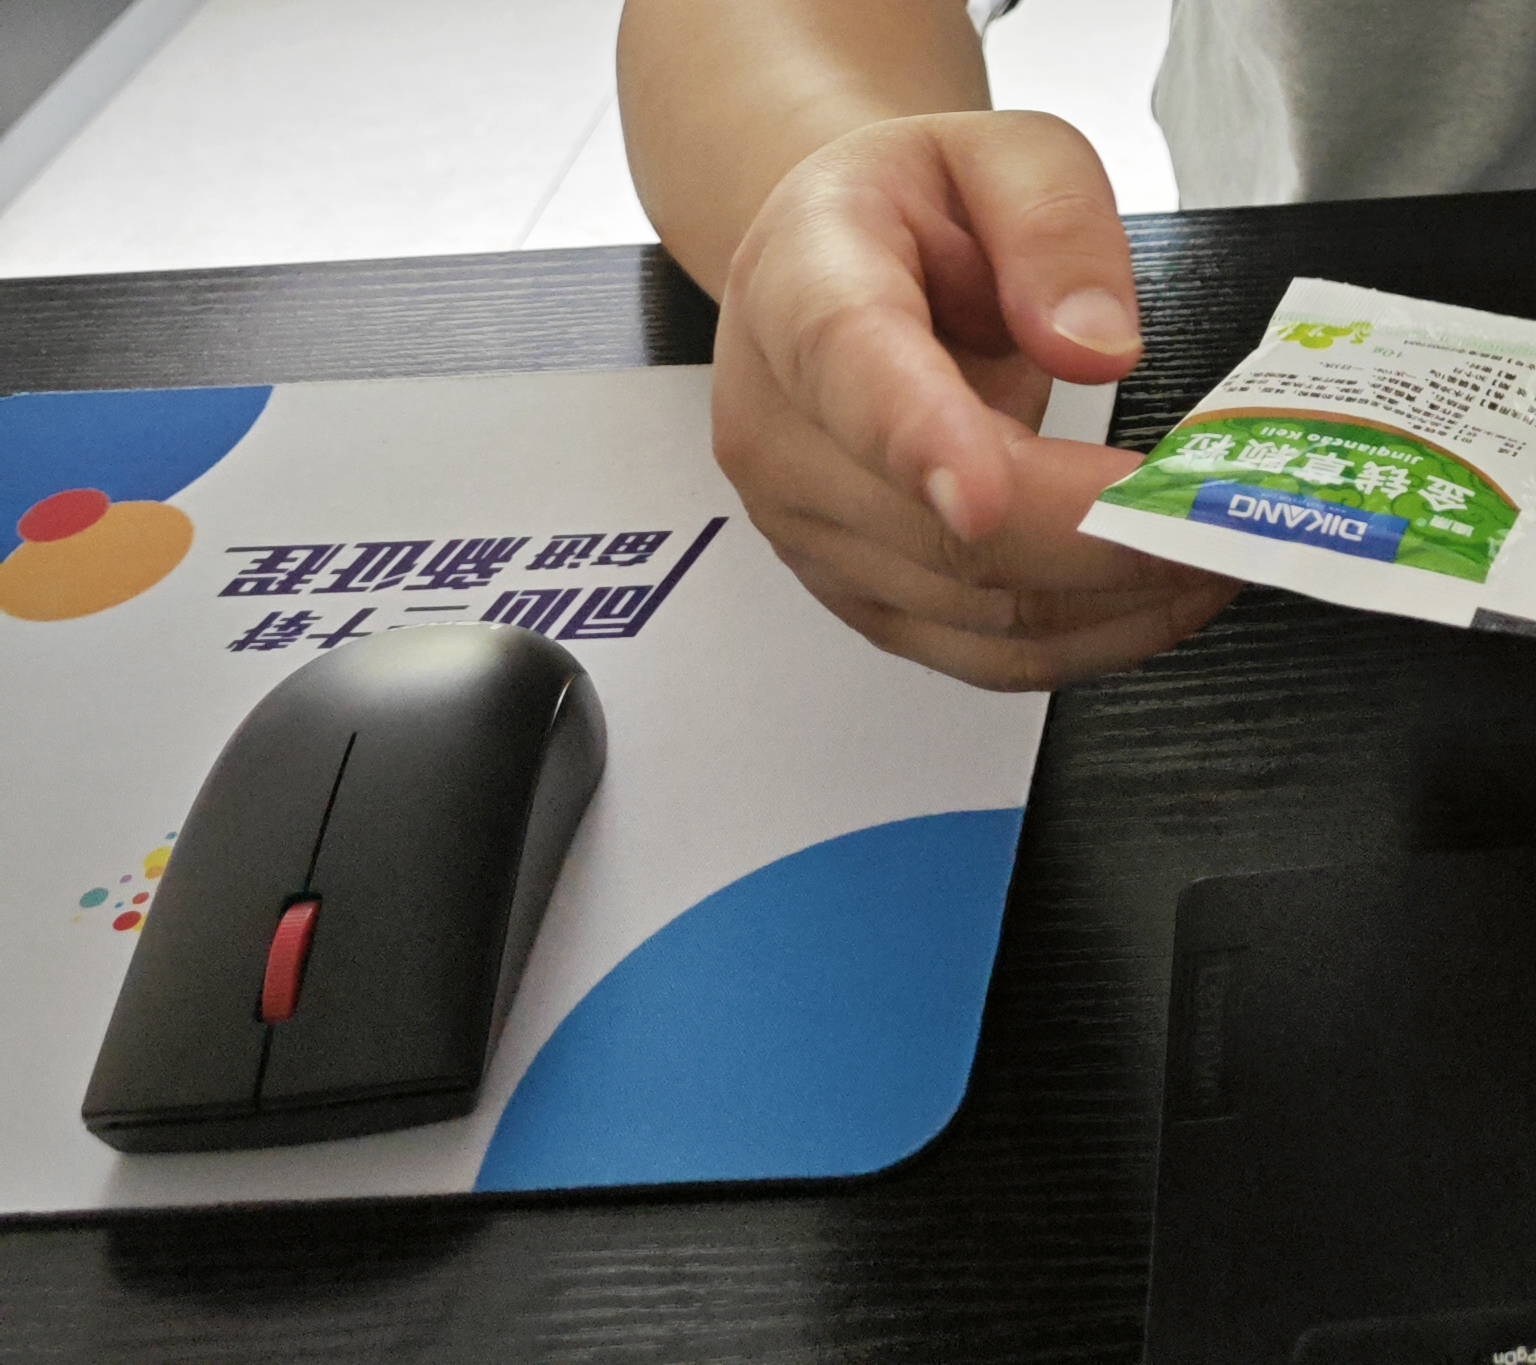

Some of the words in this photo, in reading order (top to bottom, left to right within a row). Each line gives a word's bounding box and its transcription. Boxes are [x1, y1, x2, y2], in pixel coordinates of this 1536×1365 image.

[1176, 432, 1477, 513] 金钱草颗粒
[1227, 493, 1369, 542] DIKANG
